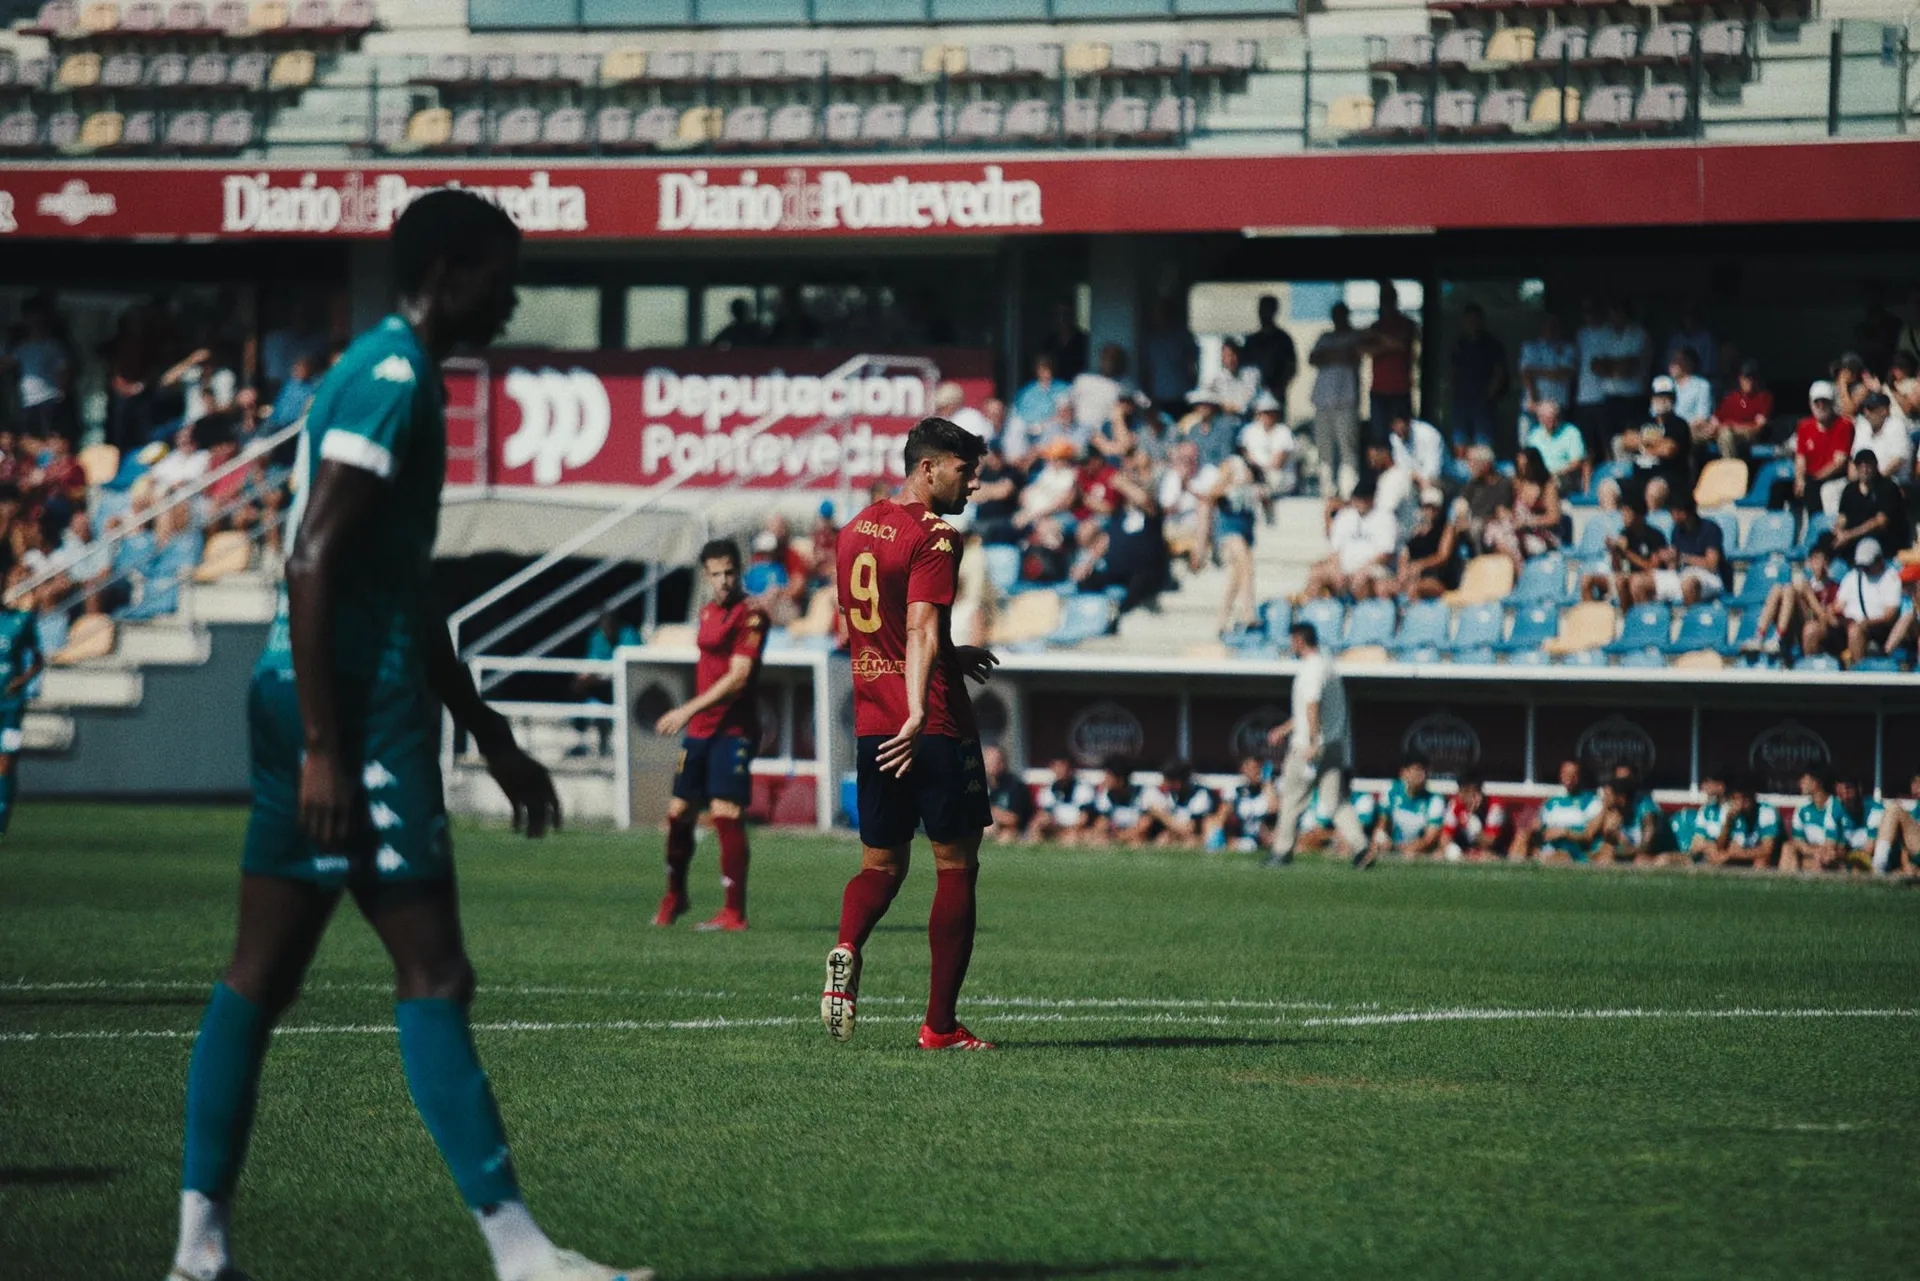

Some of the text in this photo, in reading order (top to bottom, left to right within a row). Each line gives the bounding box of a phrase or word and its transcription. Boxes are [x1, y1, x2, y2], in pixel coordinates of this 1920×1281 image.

[222, 173, 341, 232] Diario
[656, 169, 783, 231] Diario
[819, 165, 1043, 230] Pontevedra
[850, 552, 883, 634] 9
